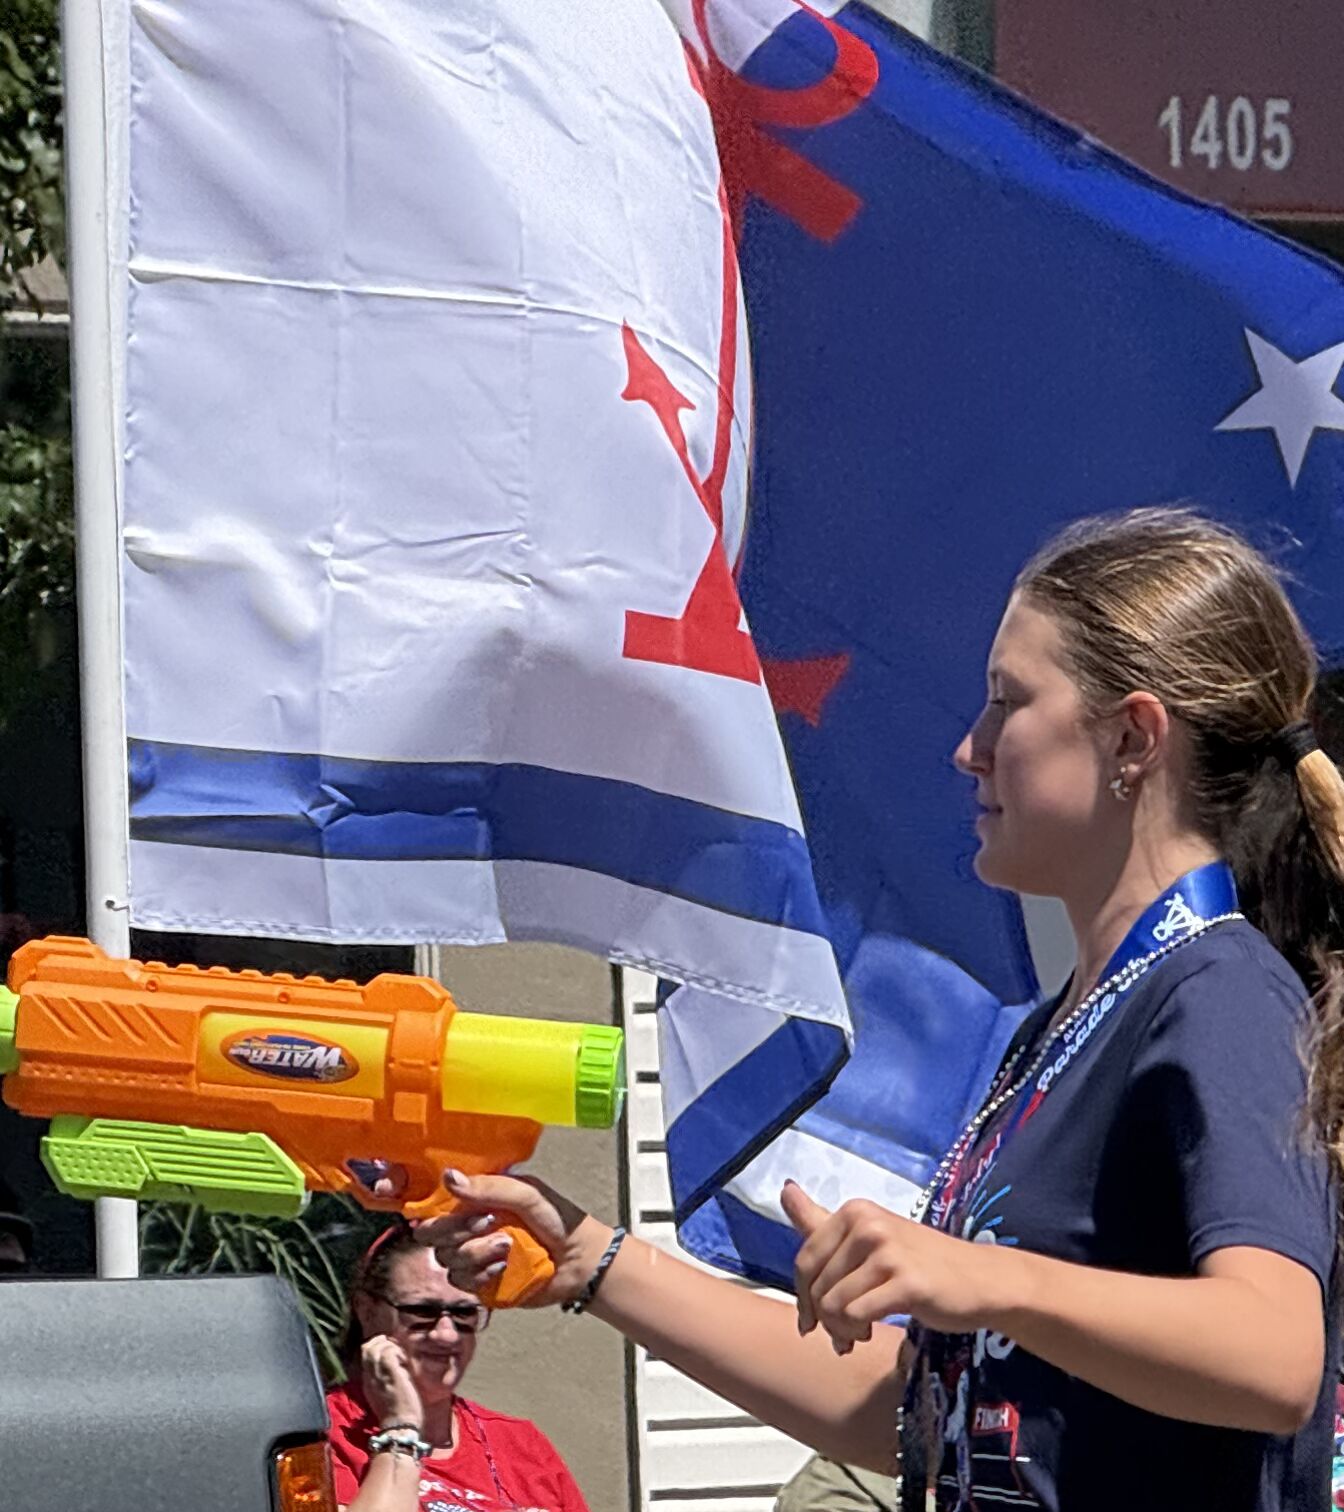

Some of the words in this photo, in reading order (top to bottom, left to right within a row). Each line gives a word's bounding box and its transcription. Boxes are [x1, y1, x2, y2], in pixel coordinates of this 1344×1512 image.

[1158, 95, 1293, 171] 1405
[248, 1045, 342, 1069] WATER
[1036, 992, 1117, 1093] Parade
